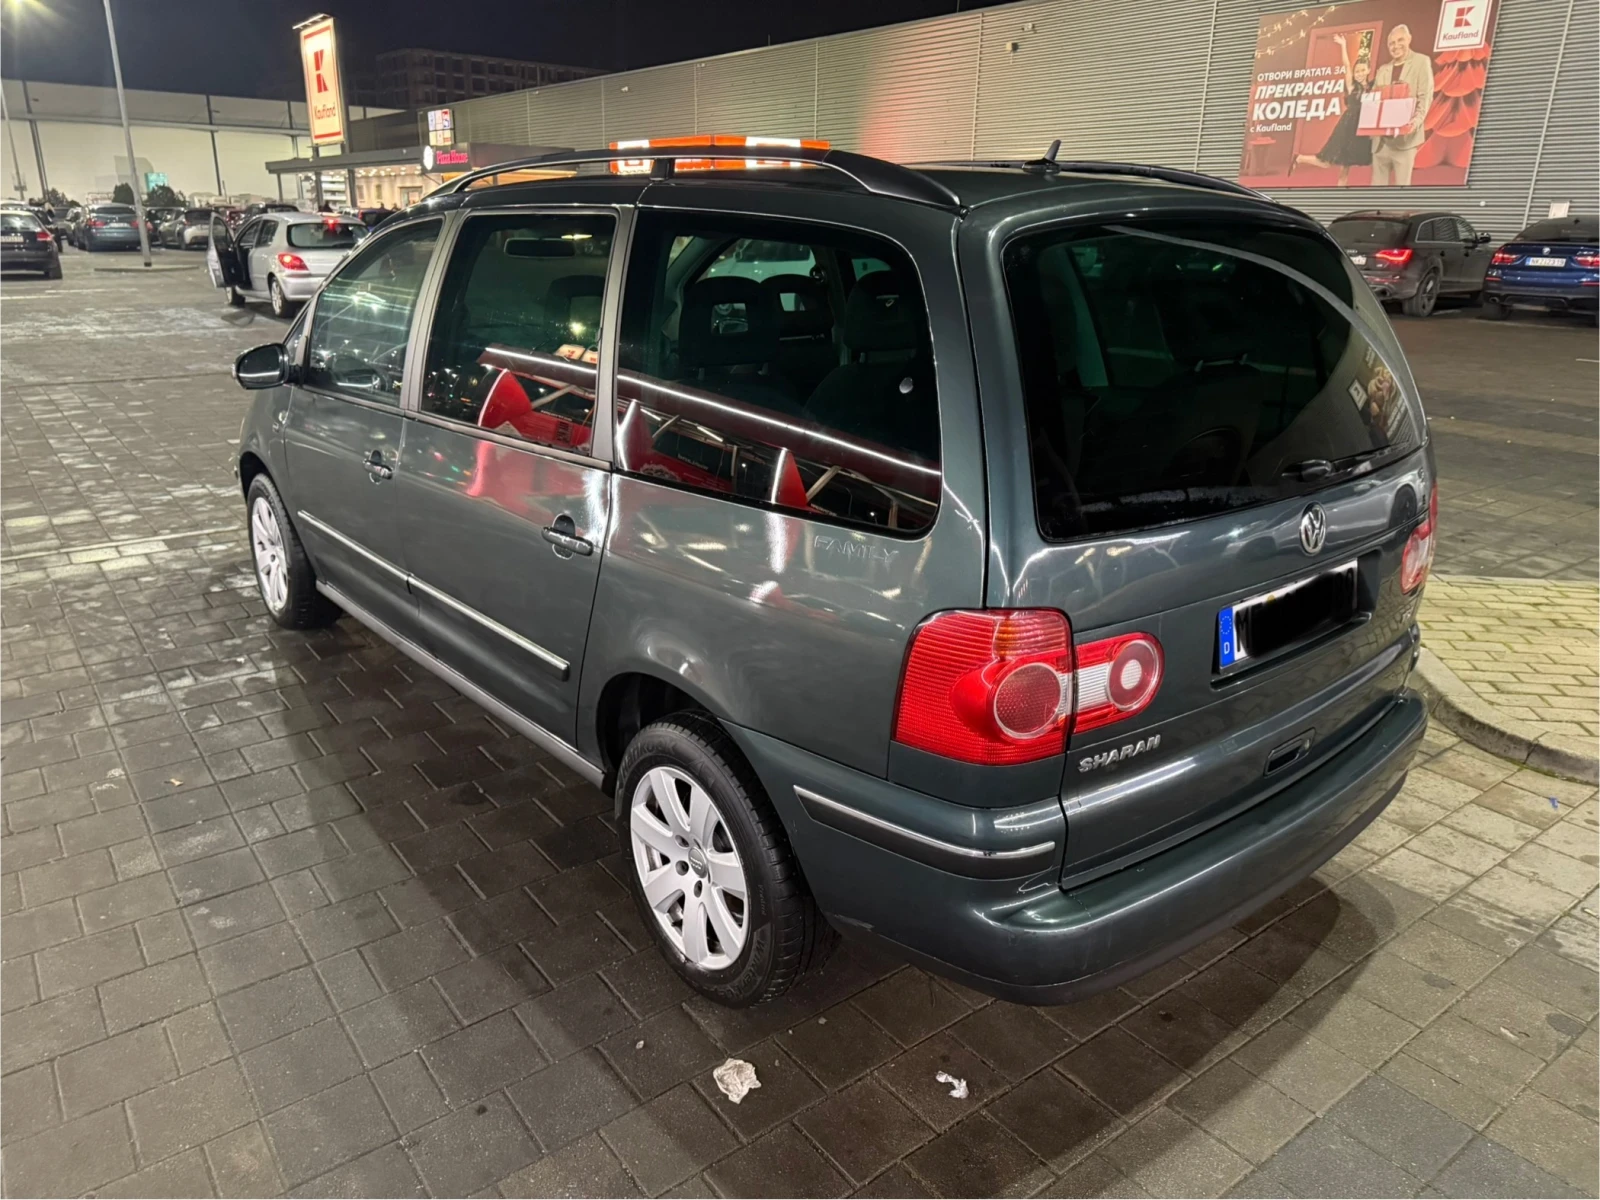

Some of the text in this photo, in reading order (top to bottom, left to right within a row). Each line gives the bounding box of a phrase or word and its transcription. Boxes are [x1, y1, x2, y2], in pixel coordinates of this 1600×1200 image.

[1442, 29, 1480, 41] Kaufland
[1257, 65, 1347, 82] ОТВОРИ ВРАТАТА ЗА
[1254, 79, 1345, 100] ПРЕКРАСНА
[314, 102, 337, 119] Kaufland
[1252, 97, 1341, 121] КОЛЕДА
[1256, 122, 1292, 133] Kaufland
[814, 535, 899, 563] FAMILY
[1223, 641, 1231, 655] D
[1078, 733, 1161, 773] SHARAN
